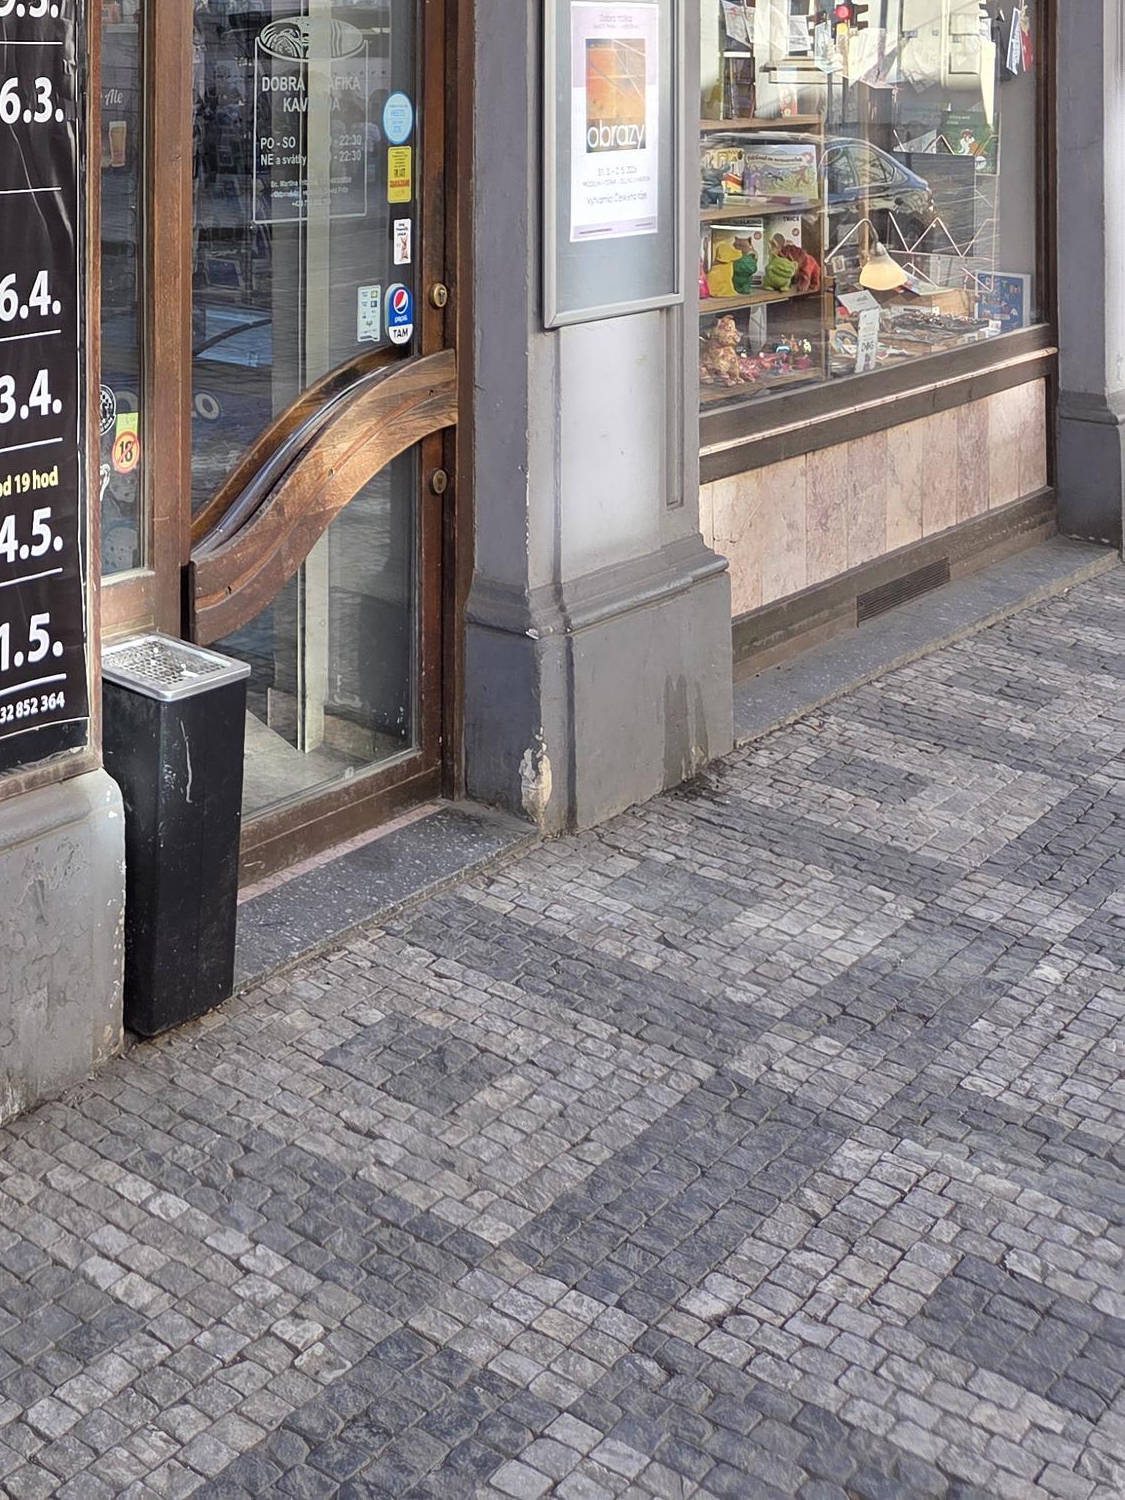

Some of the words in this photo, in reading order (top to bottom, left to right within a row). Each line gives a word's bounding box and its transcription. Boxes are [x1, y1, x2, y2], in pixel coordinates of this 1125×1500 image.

[283, 98, 341, 112] KAVA
[260, 138, 275, 149] PO
[283, 136, 296, 148] SO
[340, 134, 362, 146] 22:30
[587, 120, 644, 149] obrazy
[260, 154, 274, 166] NE
[276, 156, 280, 165] a
[339, 150, 361, 161] 22:30
[393, 328, 409, 338] TAM
[15, 473, 30, 493] 19
[33, 466, 58, 489] hod
[15, 698, 38, 718] 852
[40, 691, 65, 713] 364
